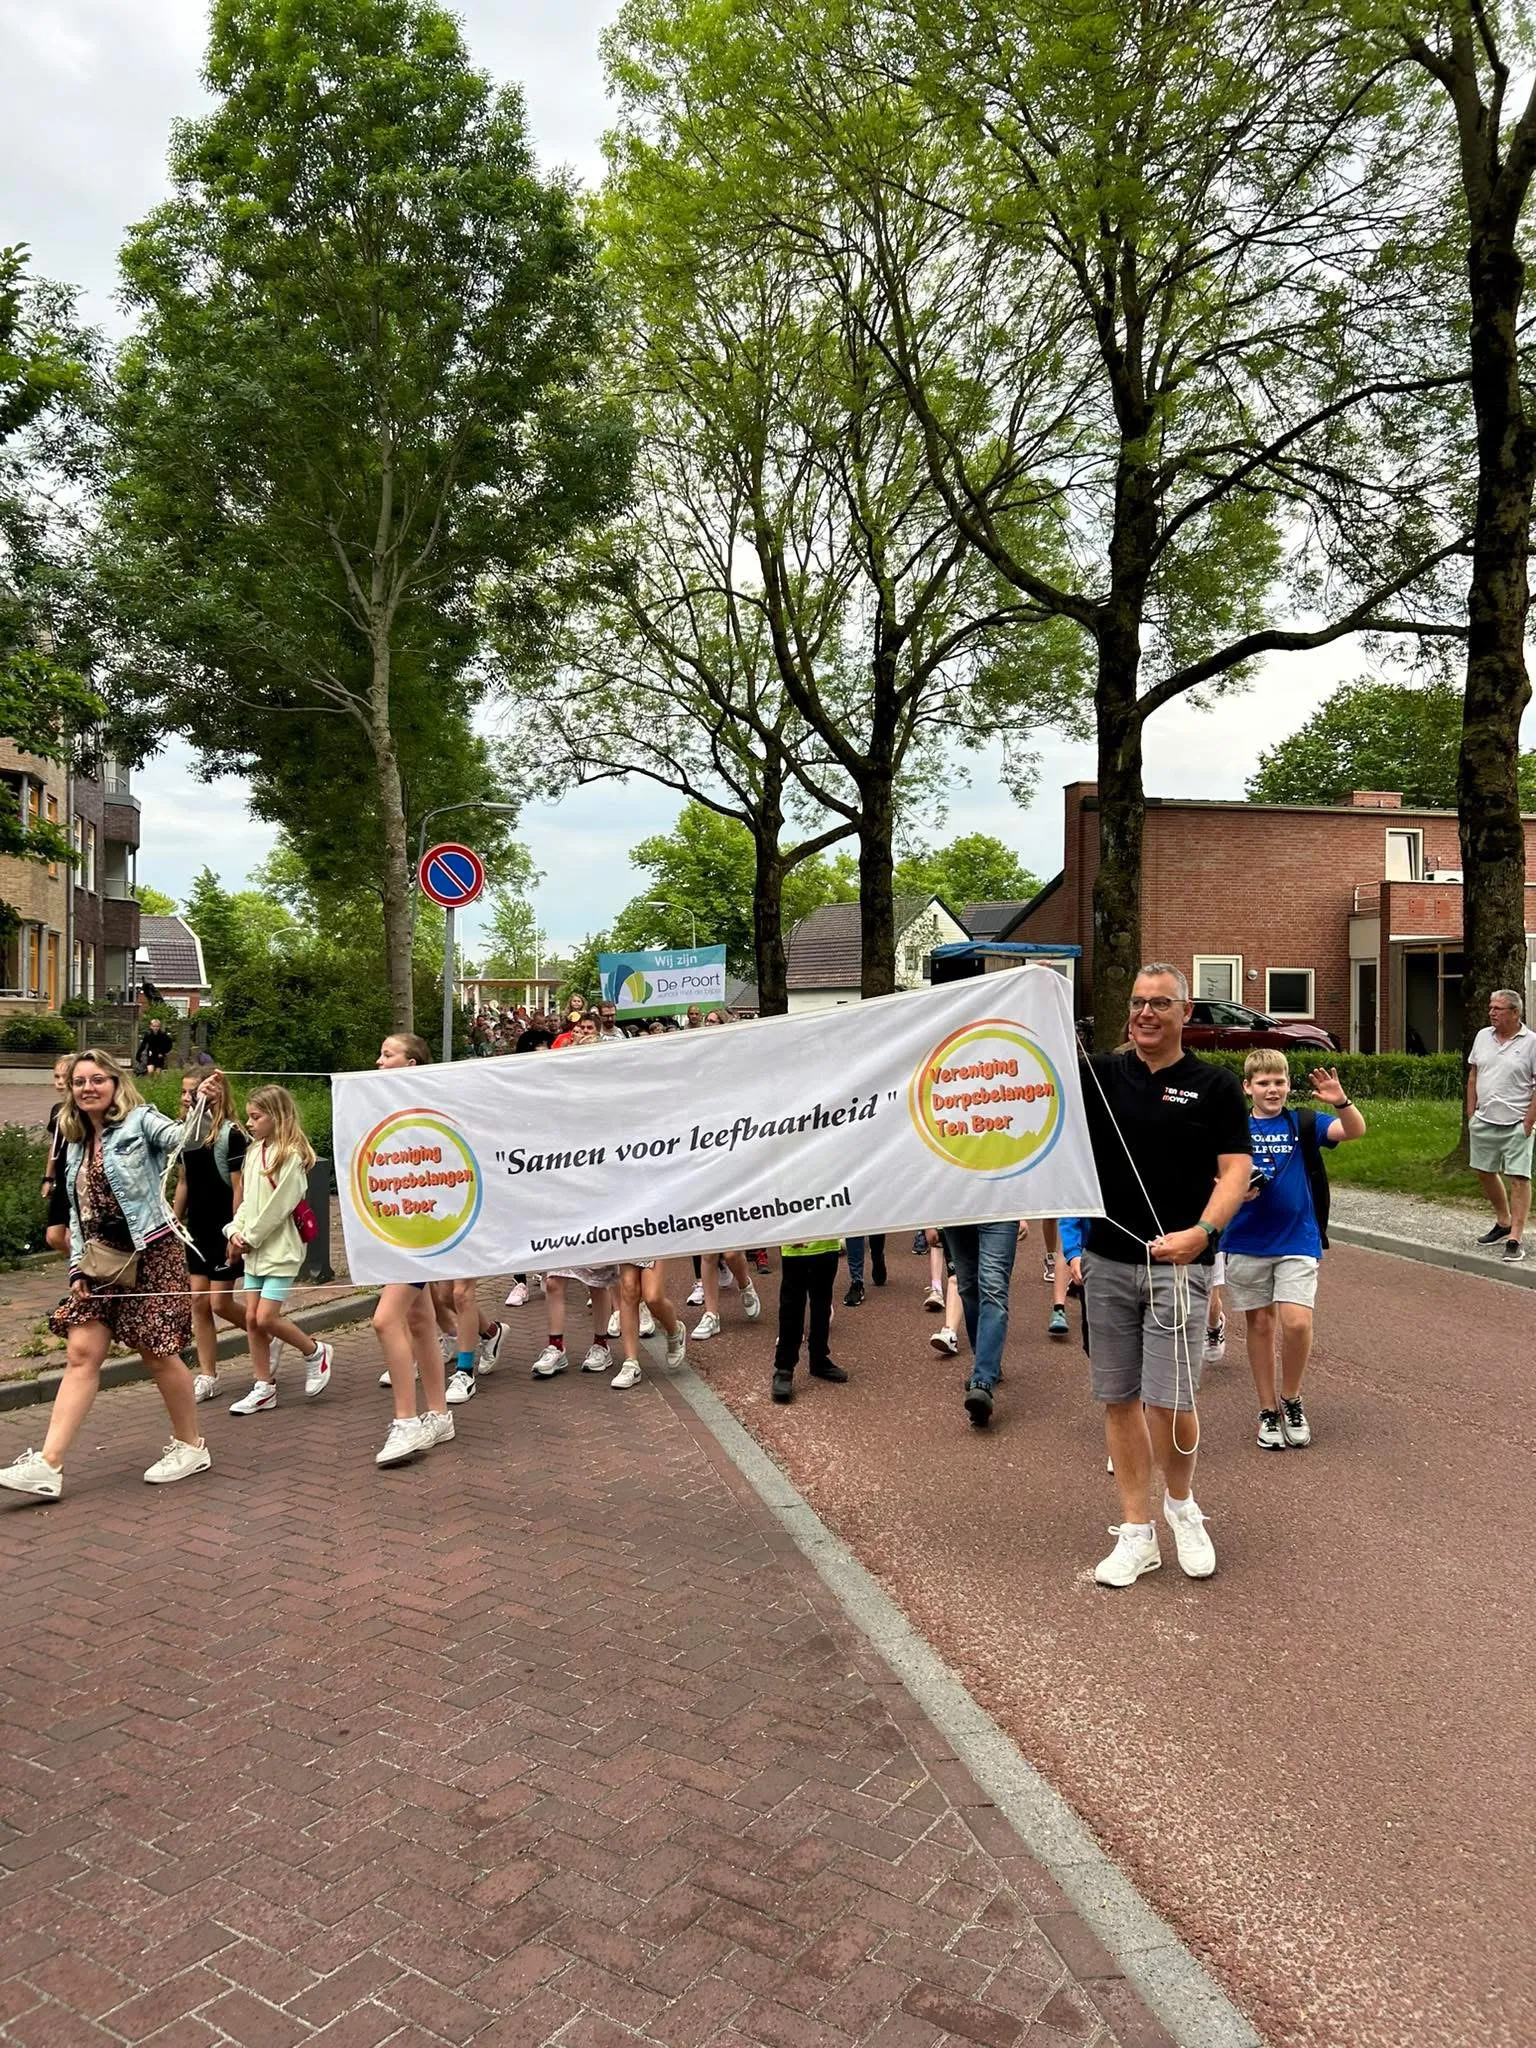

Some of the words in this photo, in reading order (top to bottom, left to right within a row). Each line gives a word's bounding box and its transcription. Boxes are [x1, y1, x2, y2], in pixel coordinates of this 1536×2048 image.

[654, 954, 673, 968] Wij
[677, 953, 698, 967] zijn
[657, 978, 678, 992] De
[682, 973, 721, 988] Poort
[928, 1058, 1018, 1084] Vereniging
[932, 1082, 1055, 1111] Dorpsbelangen
[495, 1148, 606, 1175] "Samen
[615, 1136, 681, 1162] voor
[690, 1093, 879, 1151] leefbaarheid
[936, 1118, 968, 1137] Ten
[971, 1115, 1013, 1133] Boer
[366, 1145, 442, 1167] Vereniging
[367, 1168, 474, 1194] Dorpsbelangen
[371, 1200, 400, 1218] Ten
[401, 1198, 437, 1215] Boer
[530, 1186, 852, 1252] www.dorpsbelangentenboer.nl
